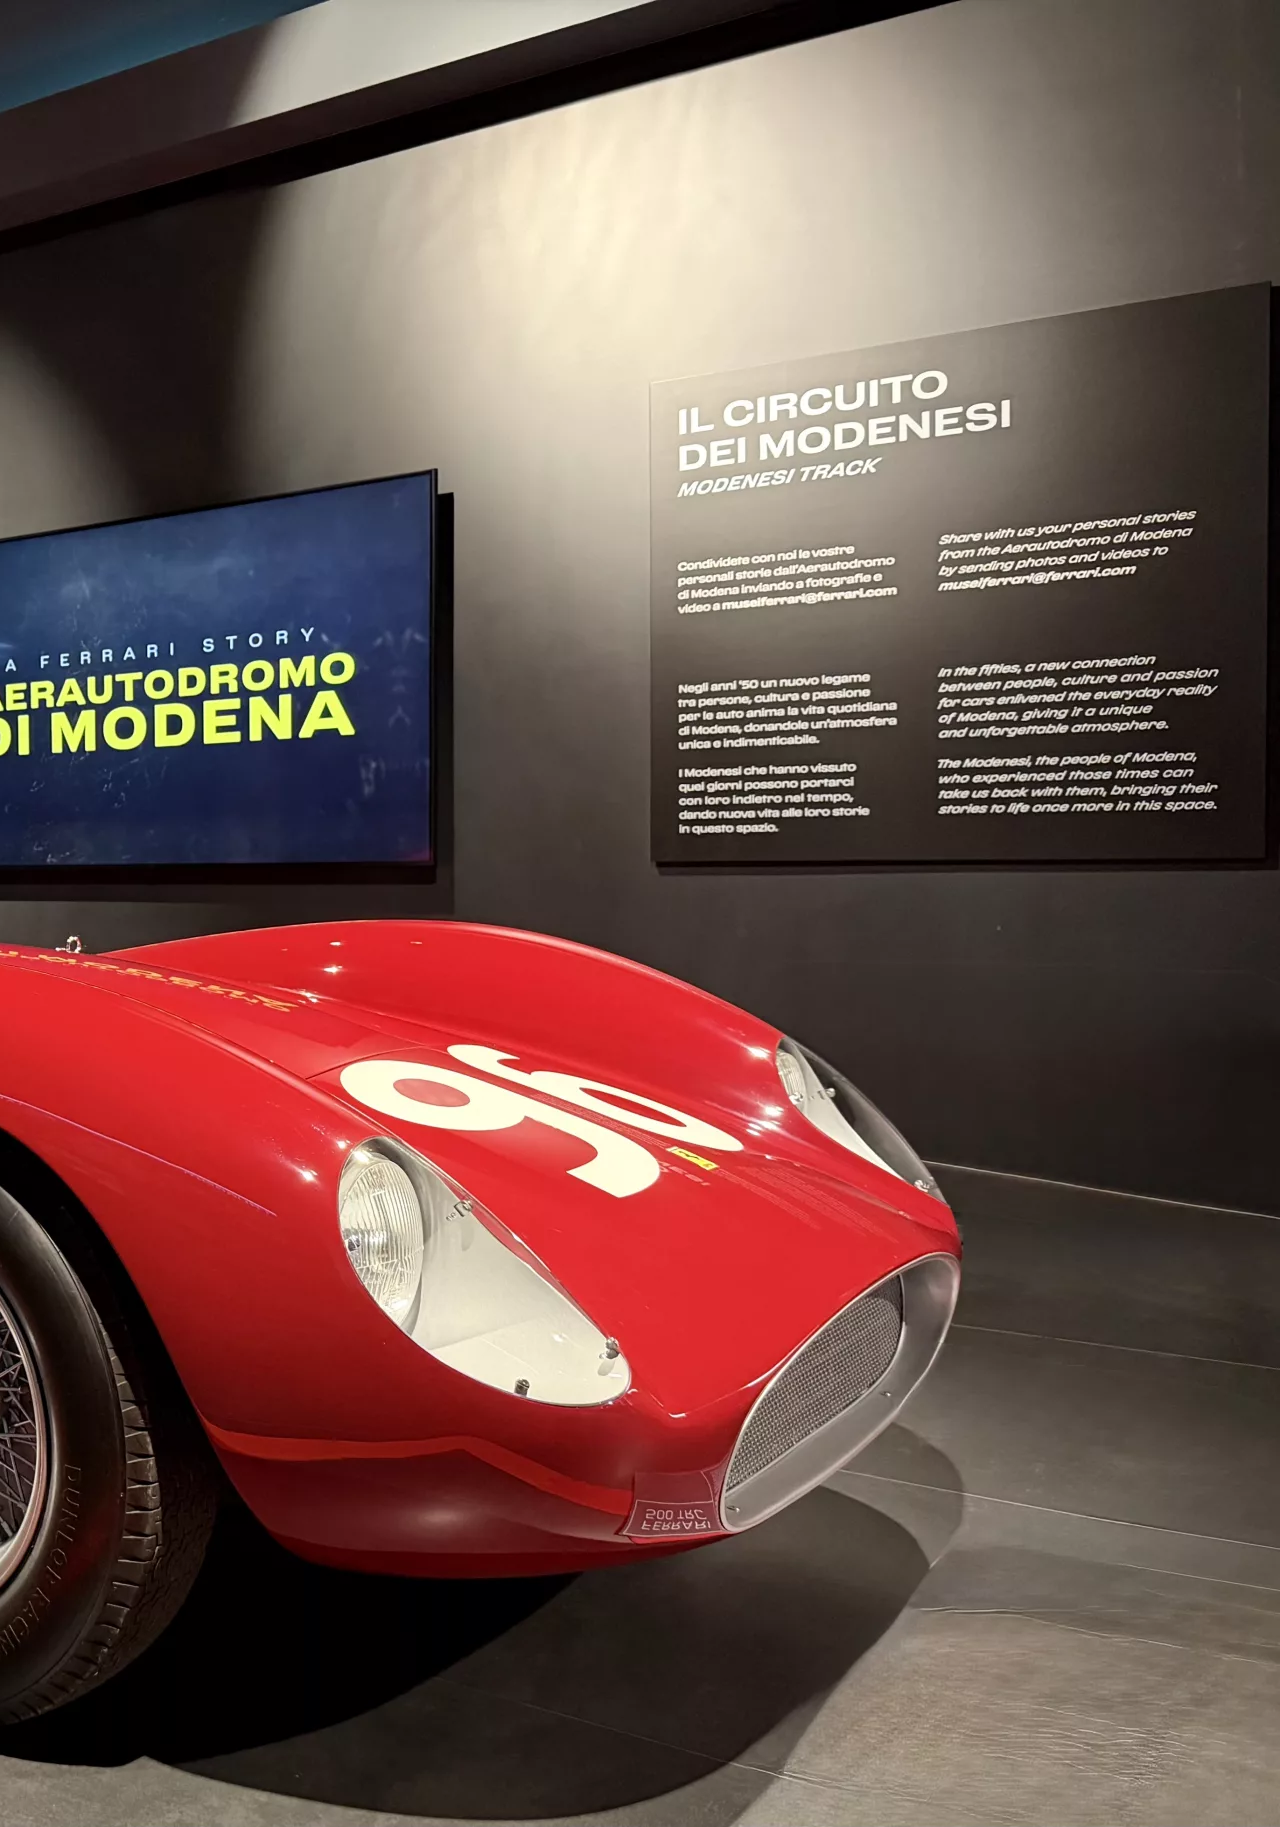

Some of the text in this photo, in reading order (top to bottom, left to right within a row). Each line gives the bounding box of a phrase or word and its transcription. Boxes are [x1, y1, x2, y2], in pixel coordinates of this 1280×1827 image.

[678, 369, 948, 434] IL CIRCUITO
[678, 399, 1012, 472] DEI MODENESI
[677, 457, 882, 497] MODENESI TRACK
[938, 510, 1196, 544] Share with us your personal stories
[938, 527, 1193, 562] from the Aerautodromo di Modena
[677, 546, 854, 571] Condividete con noi le vostre
[938, 546, 1168, 577] by sending photos and videos to
[677, 557, 895, 587] personali storie dall'Aerautodromo
[937, 565, 1136, 591] museiferrari@ferrari.com
[677, 572, 882, 599] di Modena inviando a fotografie e
[677, 586, 897, 613] video a museiferrari@ferrari.com
[5, 627, 315, 672] A FERRARI STORY
[937, 655, 1156, 677] In the fifties, a new connection
[678, 682, 709, 694] Negli
[710, 680, 737, 691] anni
[760, 679, 777, 688] un
[779, 676, 820, 687] nuovo
[821, 673, 870, 685] legame
[937, 667, 1219, 692] between people, culture and passion
[677, 688, 871, 708] tra persone, cultura e passione
[936, 683, 1218, 709] for cars enlivened the everyday reality
[51, 690, 356, 754] MODENA
[678, 701, 897, 723] per le auto anima la vita quotidiana
[938, 703, 1153, 724] of Modena, giving it a unique
[678, 716, 897, 736] di Modena, donandole un'atmosfera
[938, 719, 1168, 738] and unforgettable atmosphere.
[678, 734, 820, 750] unica e indimenticabile.
[678, 762, 856, 777] I Modenesi che hanno vissuto
[937, 751, 1197, 768] The Modenesi, the people of Modena,
[678, 776, 854, 793] quei giorni possono portarci
[938, 768, 1194, 784] who experienced those times can
[937, 782, 1218, 799] take us back with them, bringing their
[937, 799, 1217, 814] stories to life once more in this space.
[340, 1043, 744, 1198] 96
